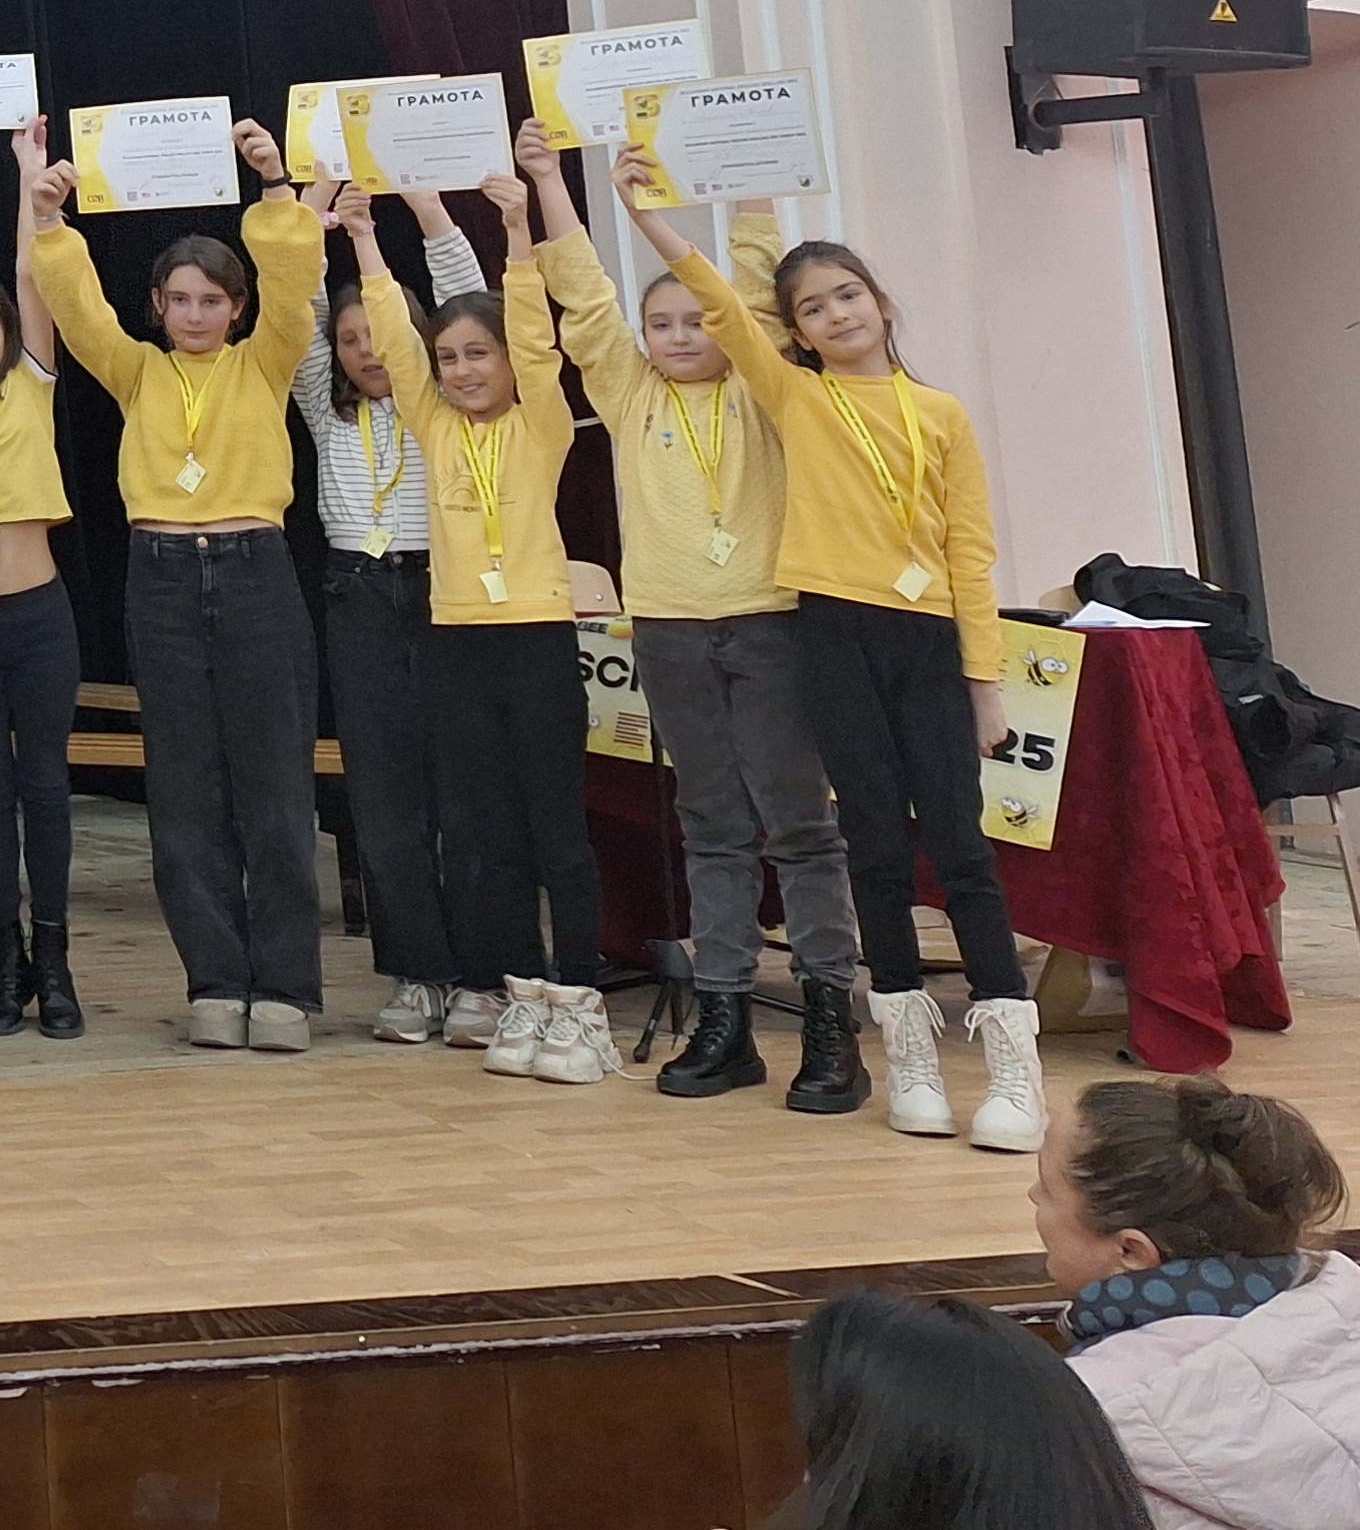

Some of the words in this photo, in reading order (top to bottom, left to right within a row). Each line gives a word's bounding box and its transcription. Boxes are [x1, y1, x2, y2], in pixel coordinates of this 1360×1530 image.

[591, 35, 684, 56] ГРАМОТА
[397, 90, 484, 107] ГРАМОТА
[691, 87, 792, 107] ГРАМОТА
[129, 110, 212, 126] ГРАМОТА
